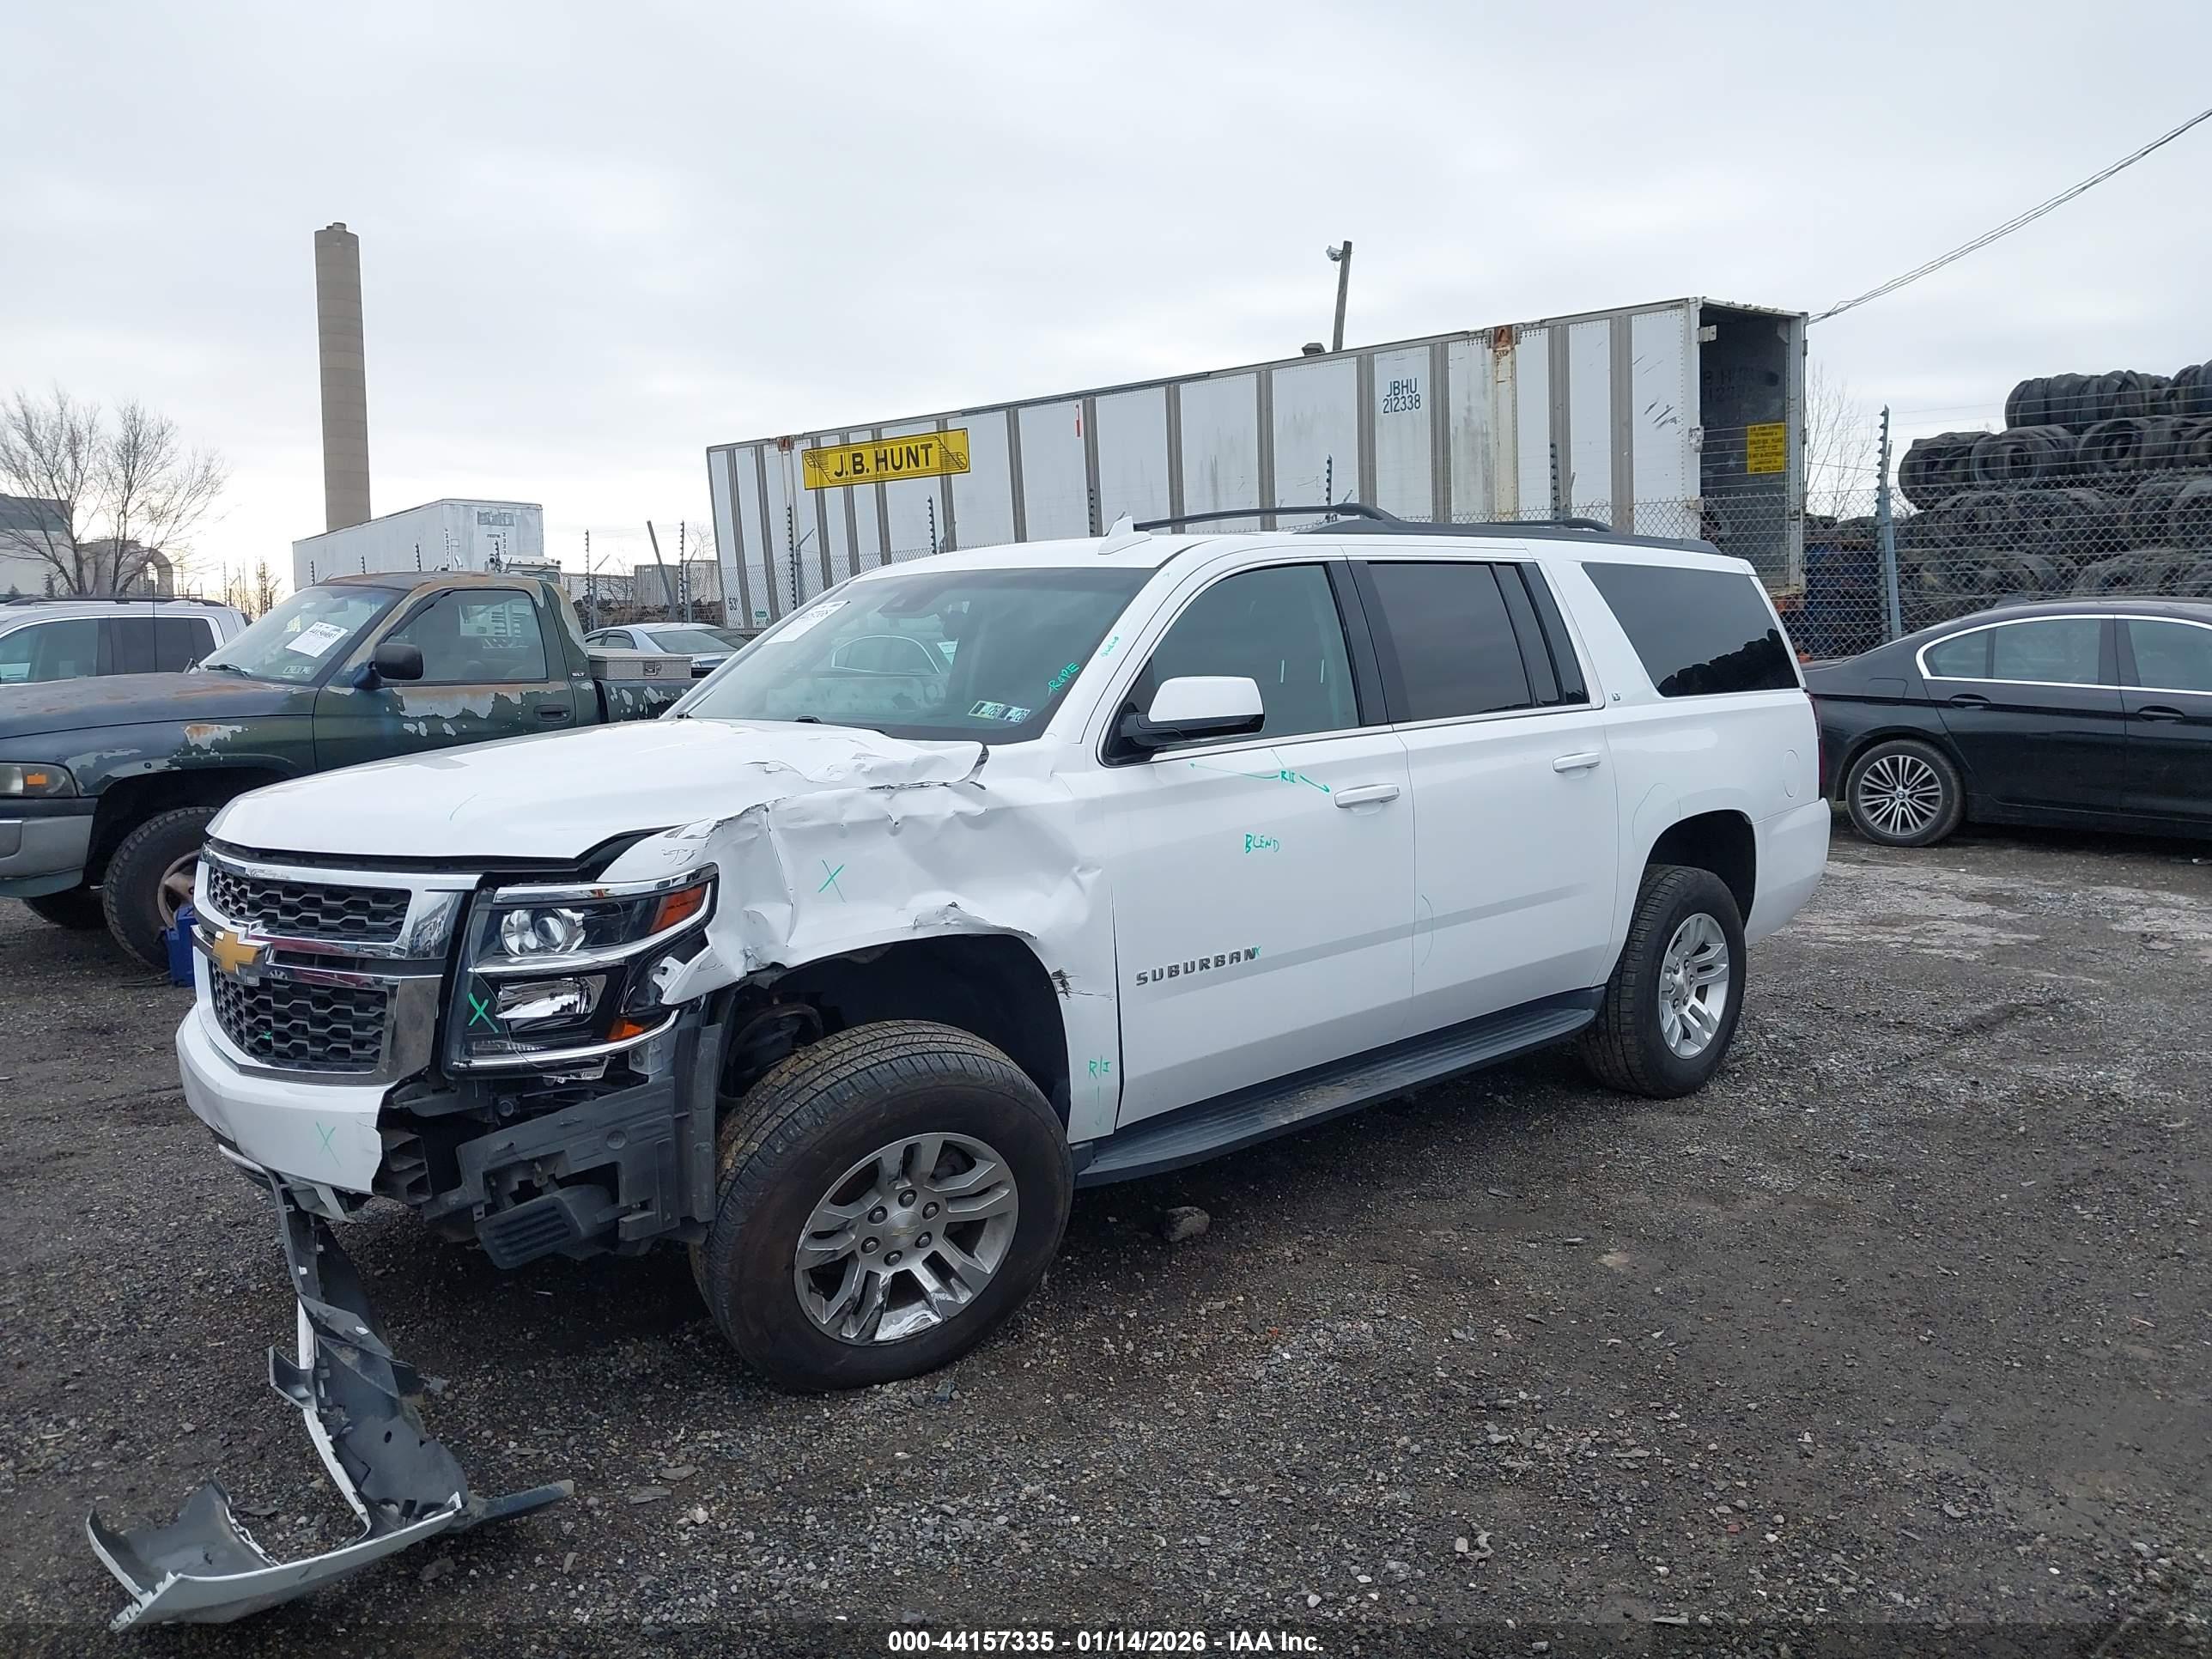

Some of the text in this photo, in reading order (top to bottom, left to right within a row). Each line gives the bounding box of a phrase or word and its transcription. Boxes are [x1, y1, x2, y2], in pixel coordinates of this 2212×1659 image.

[1386, 377, 1418, 398] JBHU
[1382, 393, 1421, 414] 212338
[875, 442, 933, 472] HUNT
[1245, 833, 1279, 854] BLEND
[1135, 947, 1256, 987] SUBURBAN
